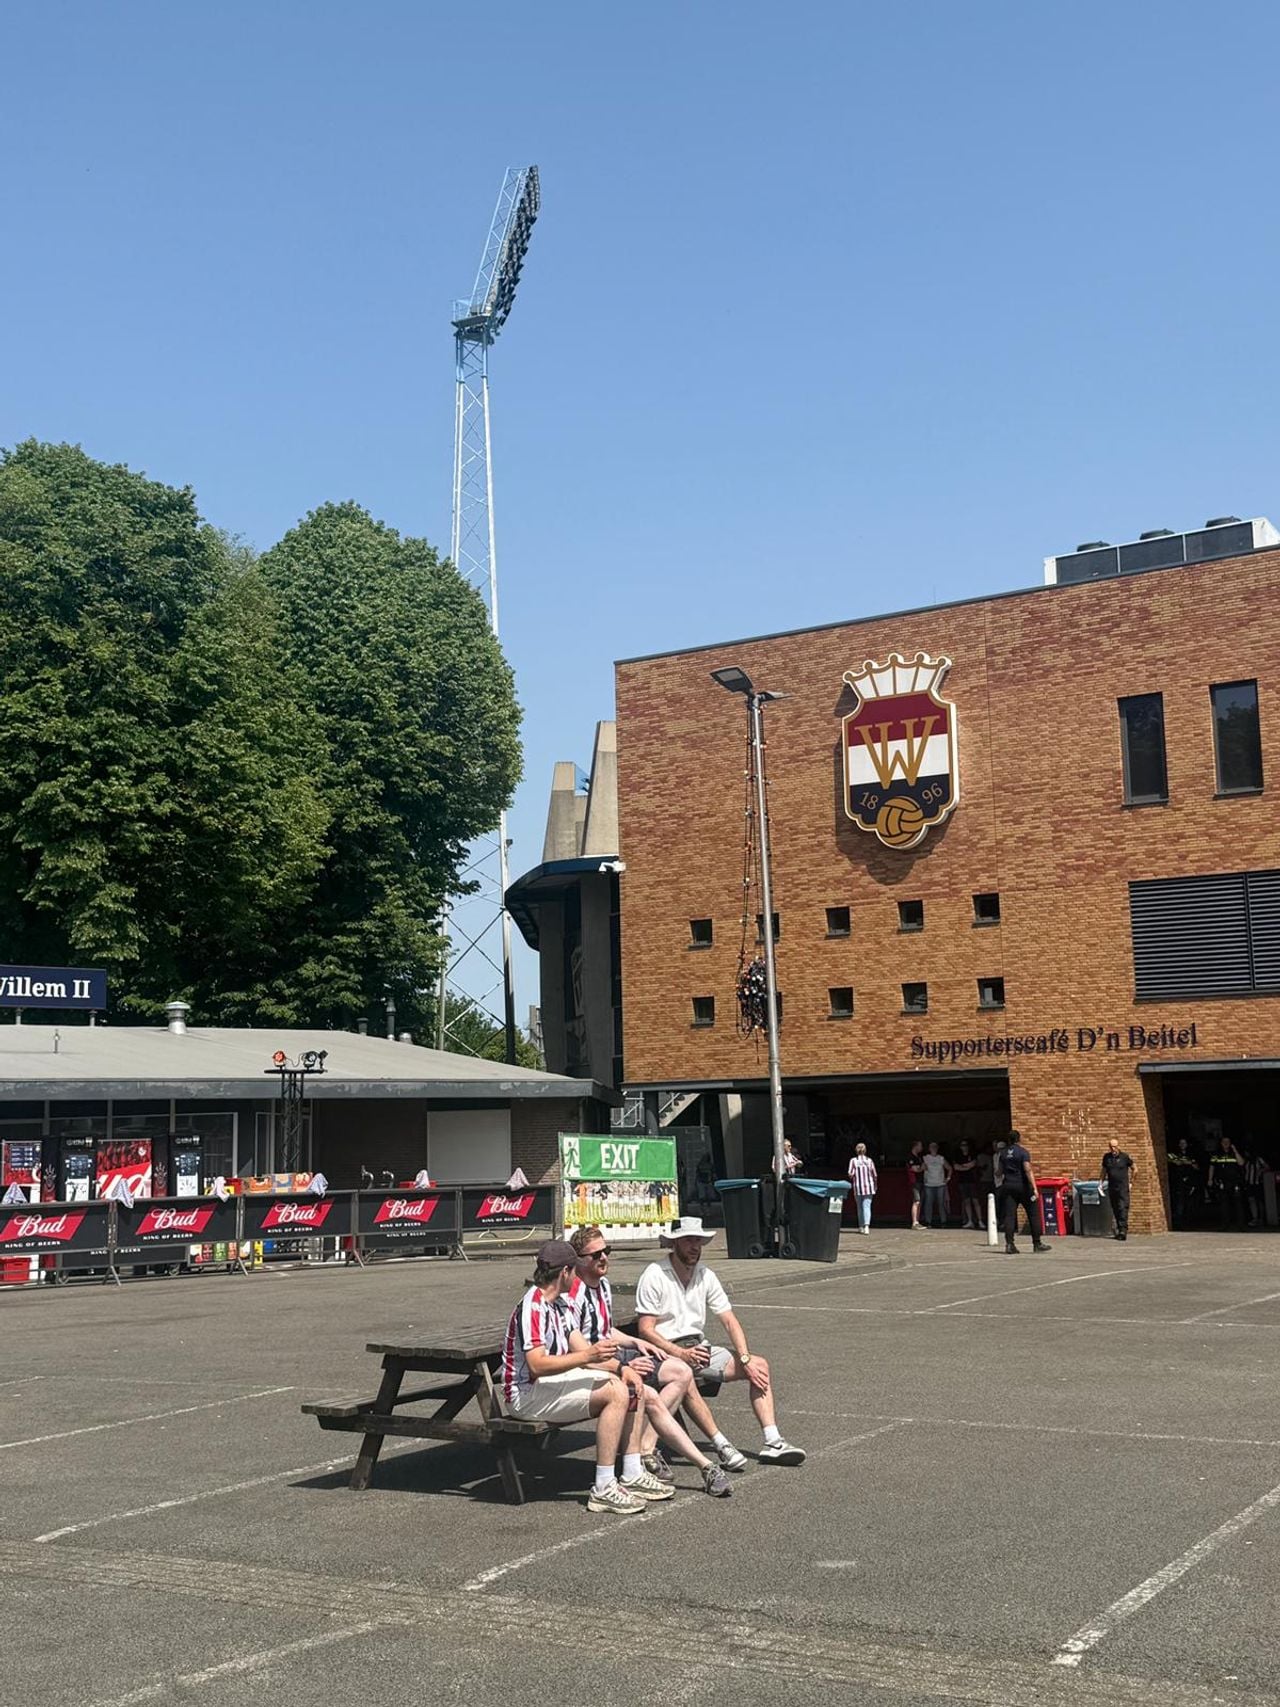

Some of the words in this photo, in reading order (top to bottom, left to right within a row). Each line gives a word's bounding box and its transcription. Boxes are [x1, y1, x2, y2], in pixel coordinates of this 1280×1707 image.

[854, 715, 940, 790] W
[859, 792, 879, 810] 18
[922, 783, 943, 804] 96
[72, 979, 91, 999] II
[911, 1028, 1069, 1064] Supporterscafé
[1128, 1022, 1198, 1050] Beitel
[600, 1142, 640, 1169] EXIT
[274, 1202, 318, 1223] Bud
[386, 1199, 425, 1218] Bud
[487, 1194, 523, 1213] Bud
[14, 1213, 68, 1236] Bud
[151, 1207, 199, 1229] Bud
